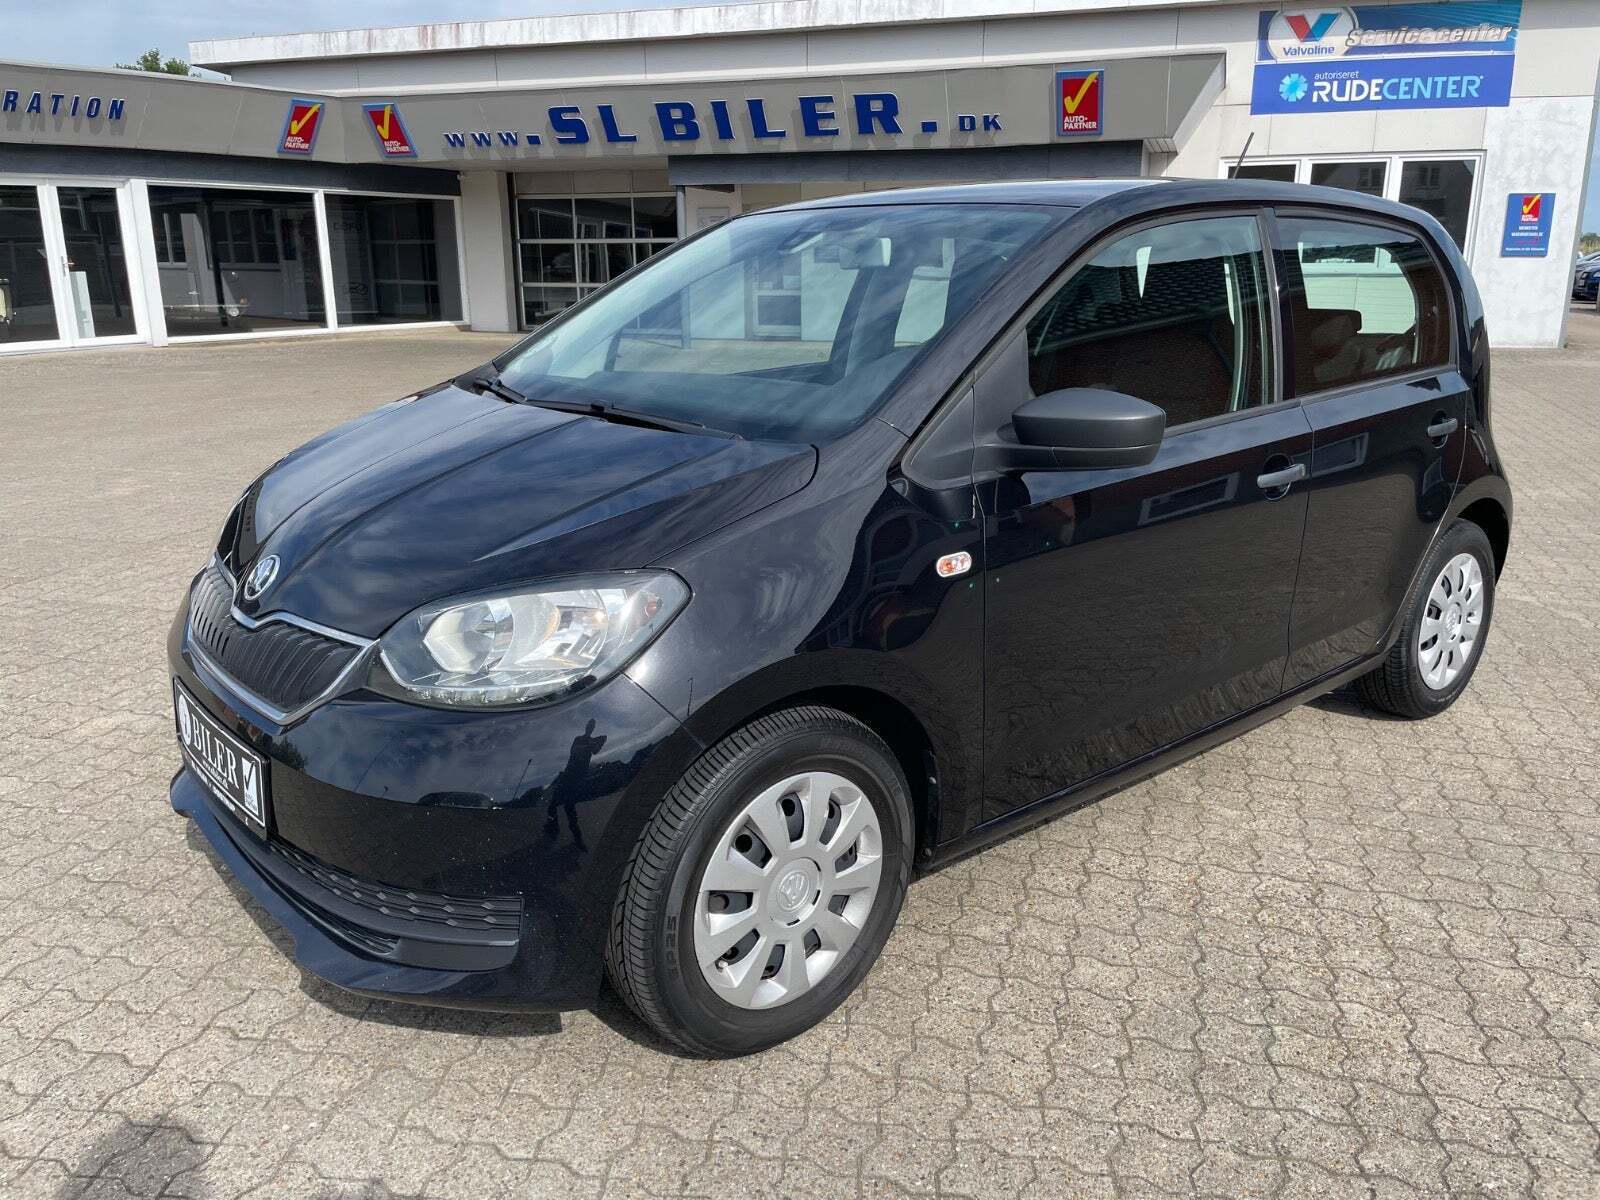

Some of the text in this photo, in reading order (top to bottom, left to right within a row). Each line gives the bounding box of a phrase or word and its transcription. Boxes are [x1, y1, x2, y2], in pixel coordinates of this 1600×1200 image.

[1347, 23, 1513, 47] Servicecenter
[1283, 45, 1335, 56] Valvoline
[1315, 70, 1360, 80] autoriseret
[1312, 75, 1482, 102] RUDECENTER
[2, 89, 126, 119] RATION
[1064, 115, 1088, 123] AUTO-
[191, 713, 240, 790] BILER
